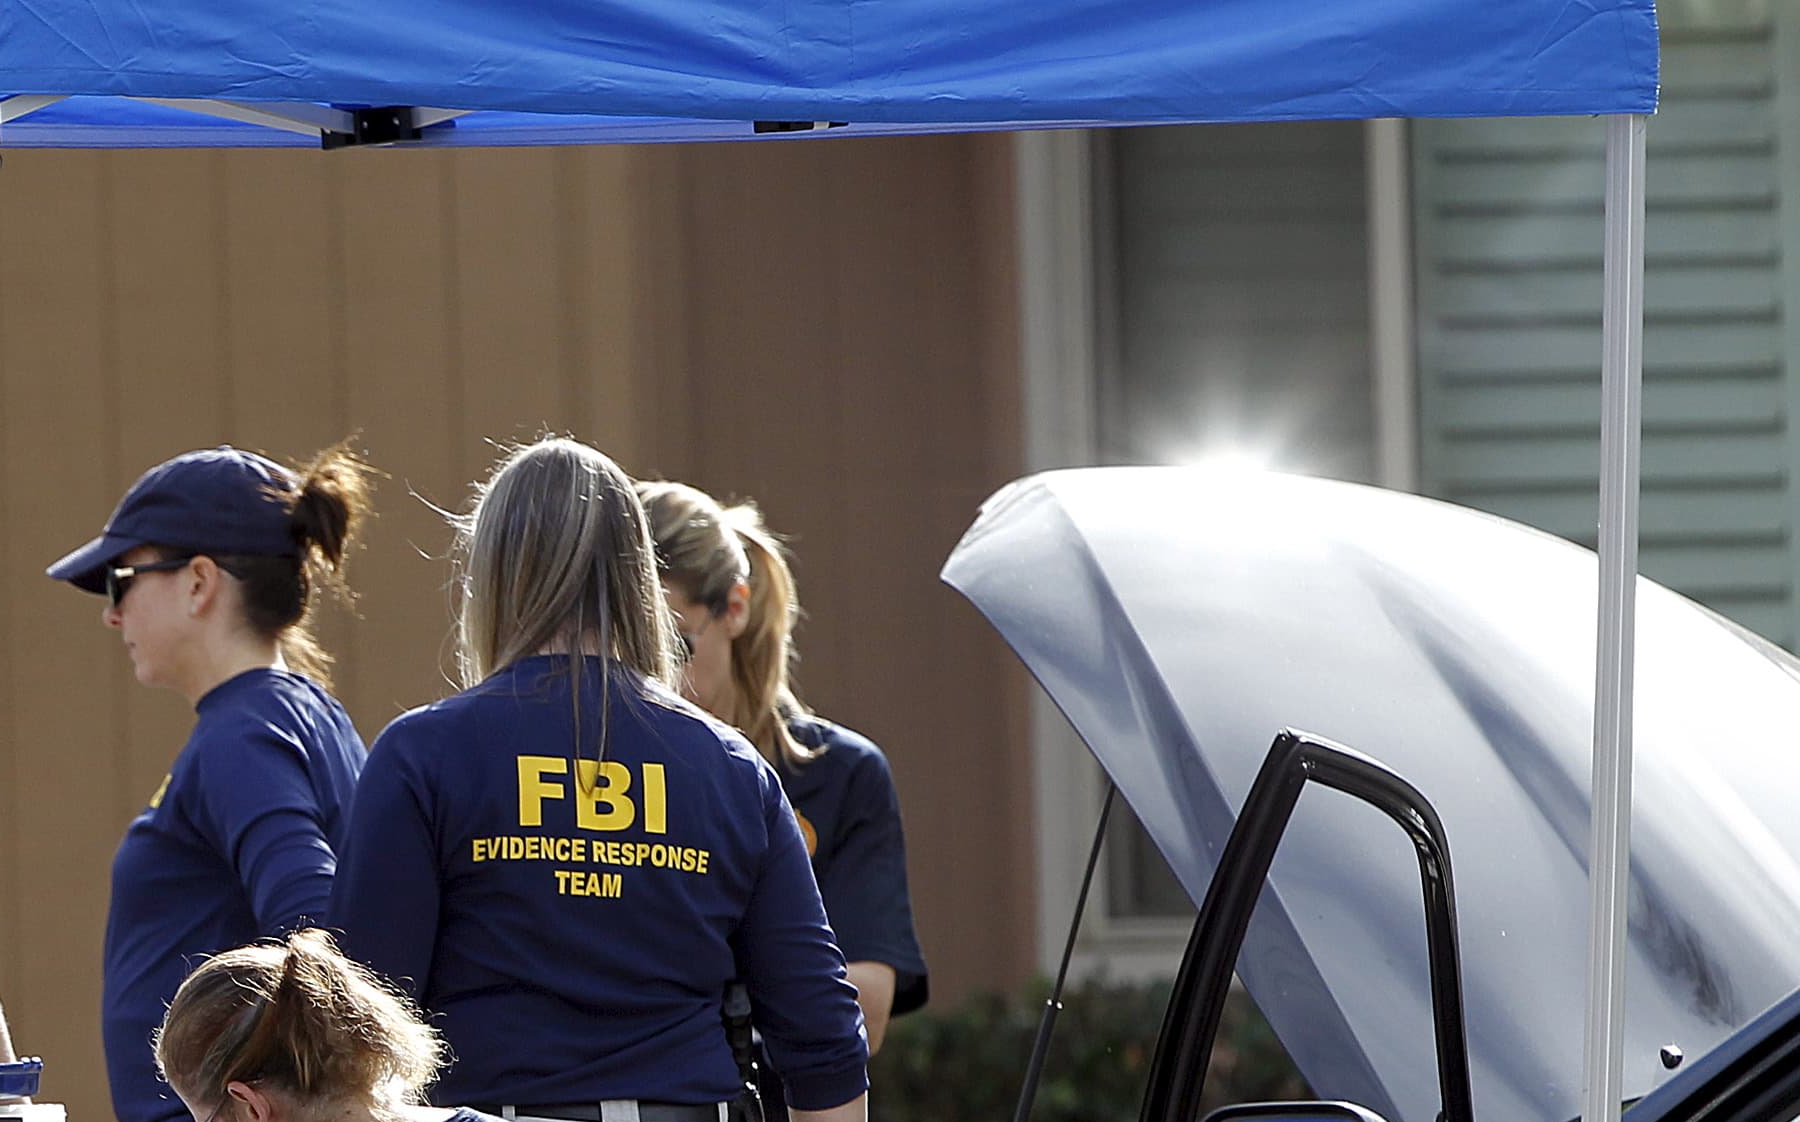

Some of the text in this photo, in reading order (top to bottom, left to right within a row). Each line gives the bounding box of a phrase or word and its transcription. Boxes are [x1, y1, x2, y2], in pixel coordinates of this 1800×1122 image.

[517, 756, 667, 834] FBI
[472, 837, 710, 874] EVIDENCE RESPONSE
[554, 870, 622, 898] TEAM
